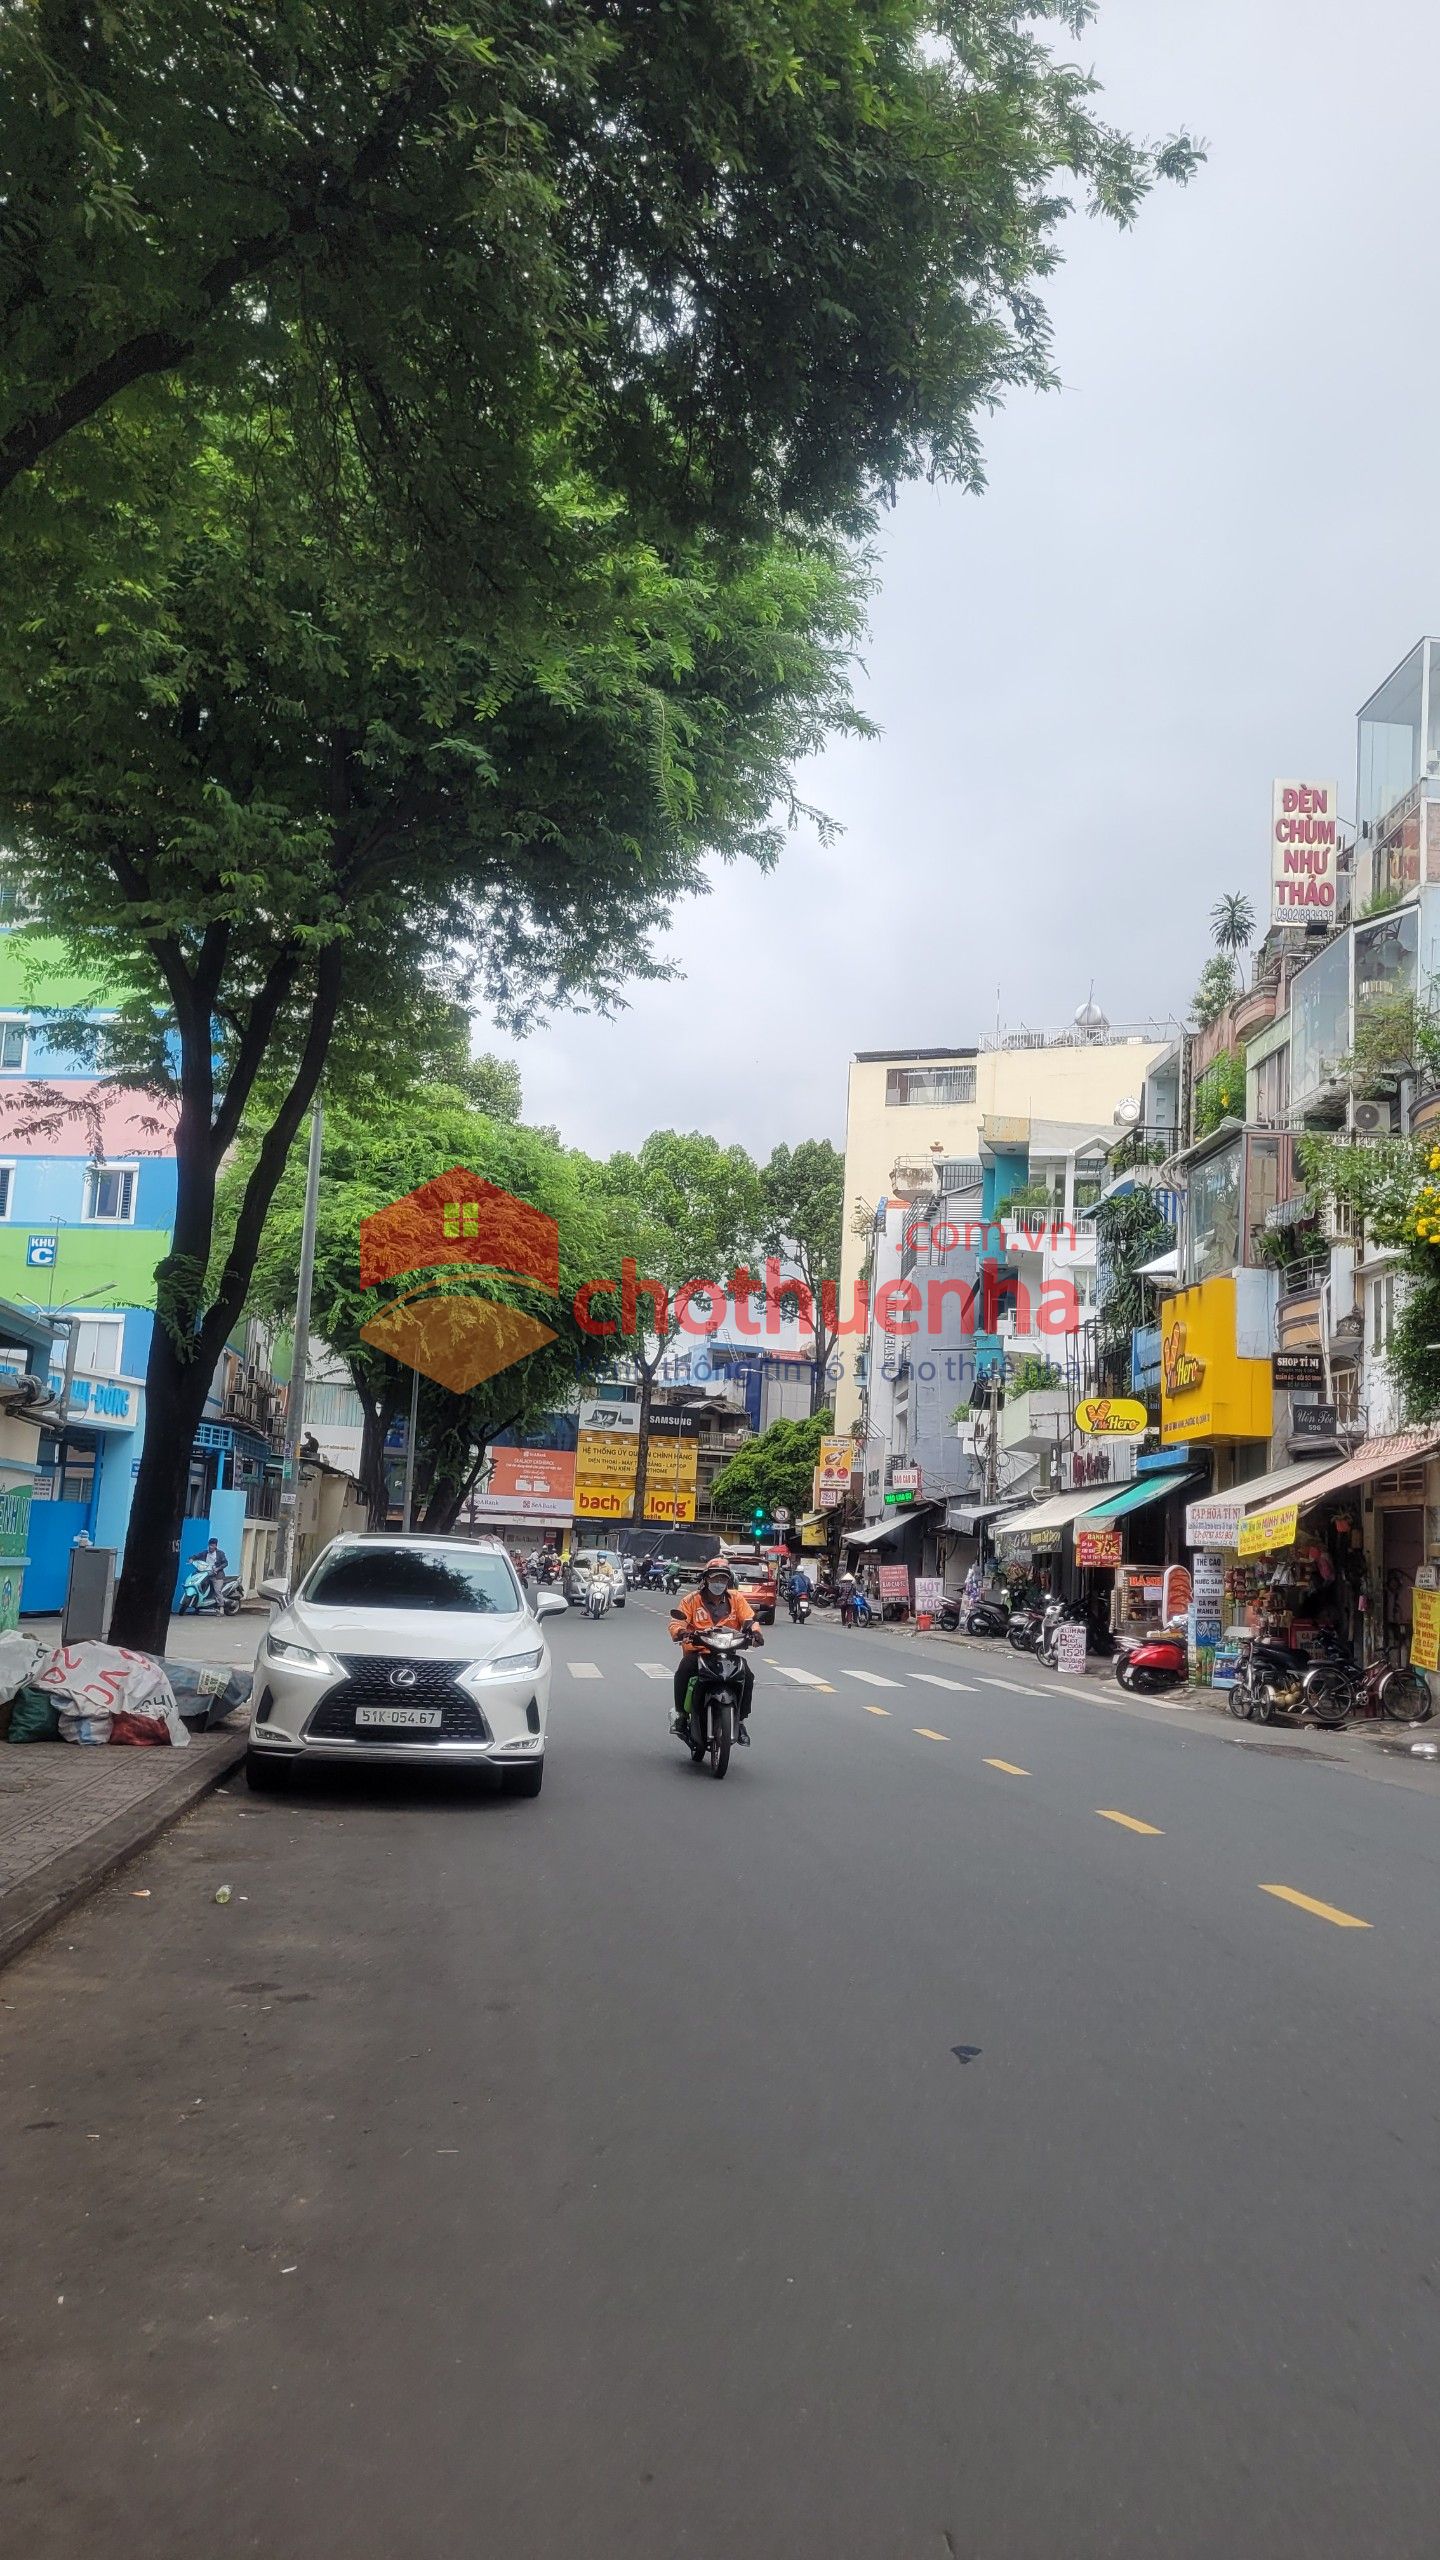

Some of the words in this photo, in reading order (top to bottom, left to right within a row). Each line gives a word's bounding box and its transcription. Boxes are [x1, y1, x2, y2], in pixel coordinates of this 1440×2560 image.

[1283, 784, 1328, 814] ĐÈN
[1275, 815, 1336, 845] CHÙM
[1284, 846, 1331, 875] NHƯ
[1275, 874, 1335, 907] THẢO
[31, 1238, 55, 1247] KHU
[31, 1248, 53, 1264] C
[1277, 1357, 1298, 1367] SHOP
[649, 1415, 692, 1426] SAMSUNG
[1107, 1415, 1140, 1431] Hero
[650, 1497, 687, 1518] long
[362, 1710, 436, 1725] 51K-054.67
